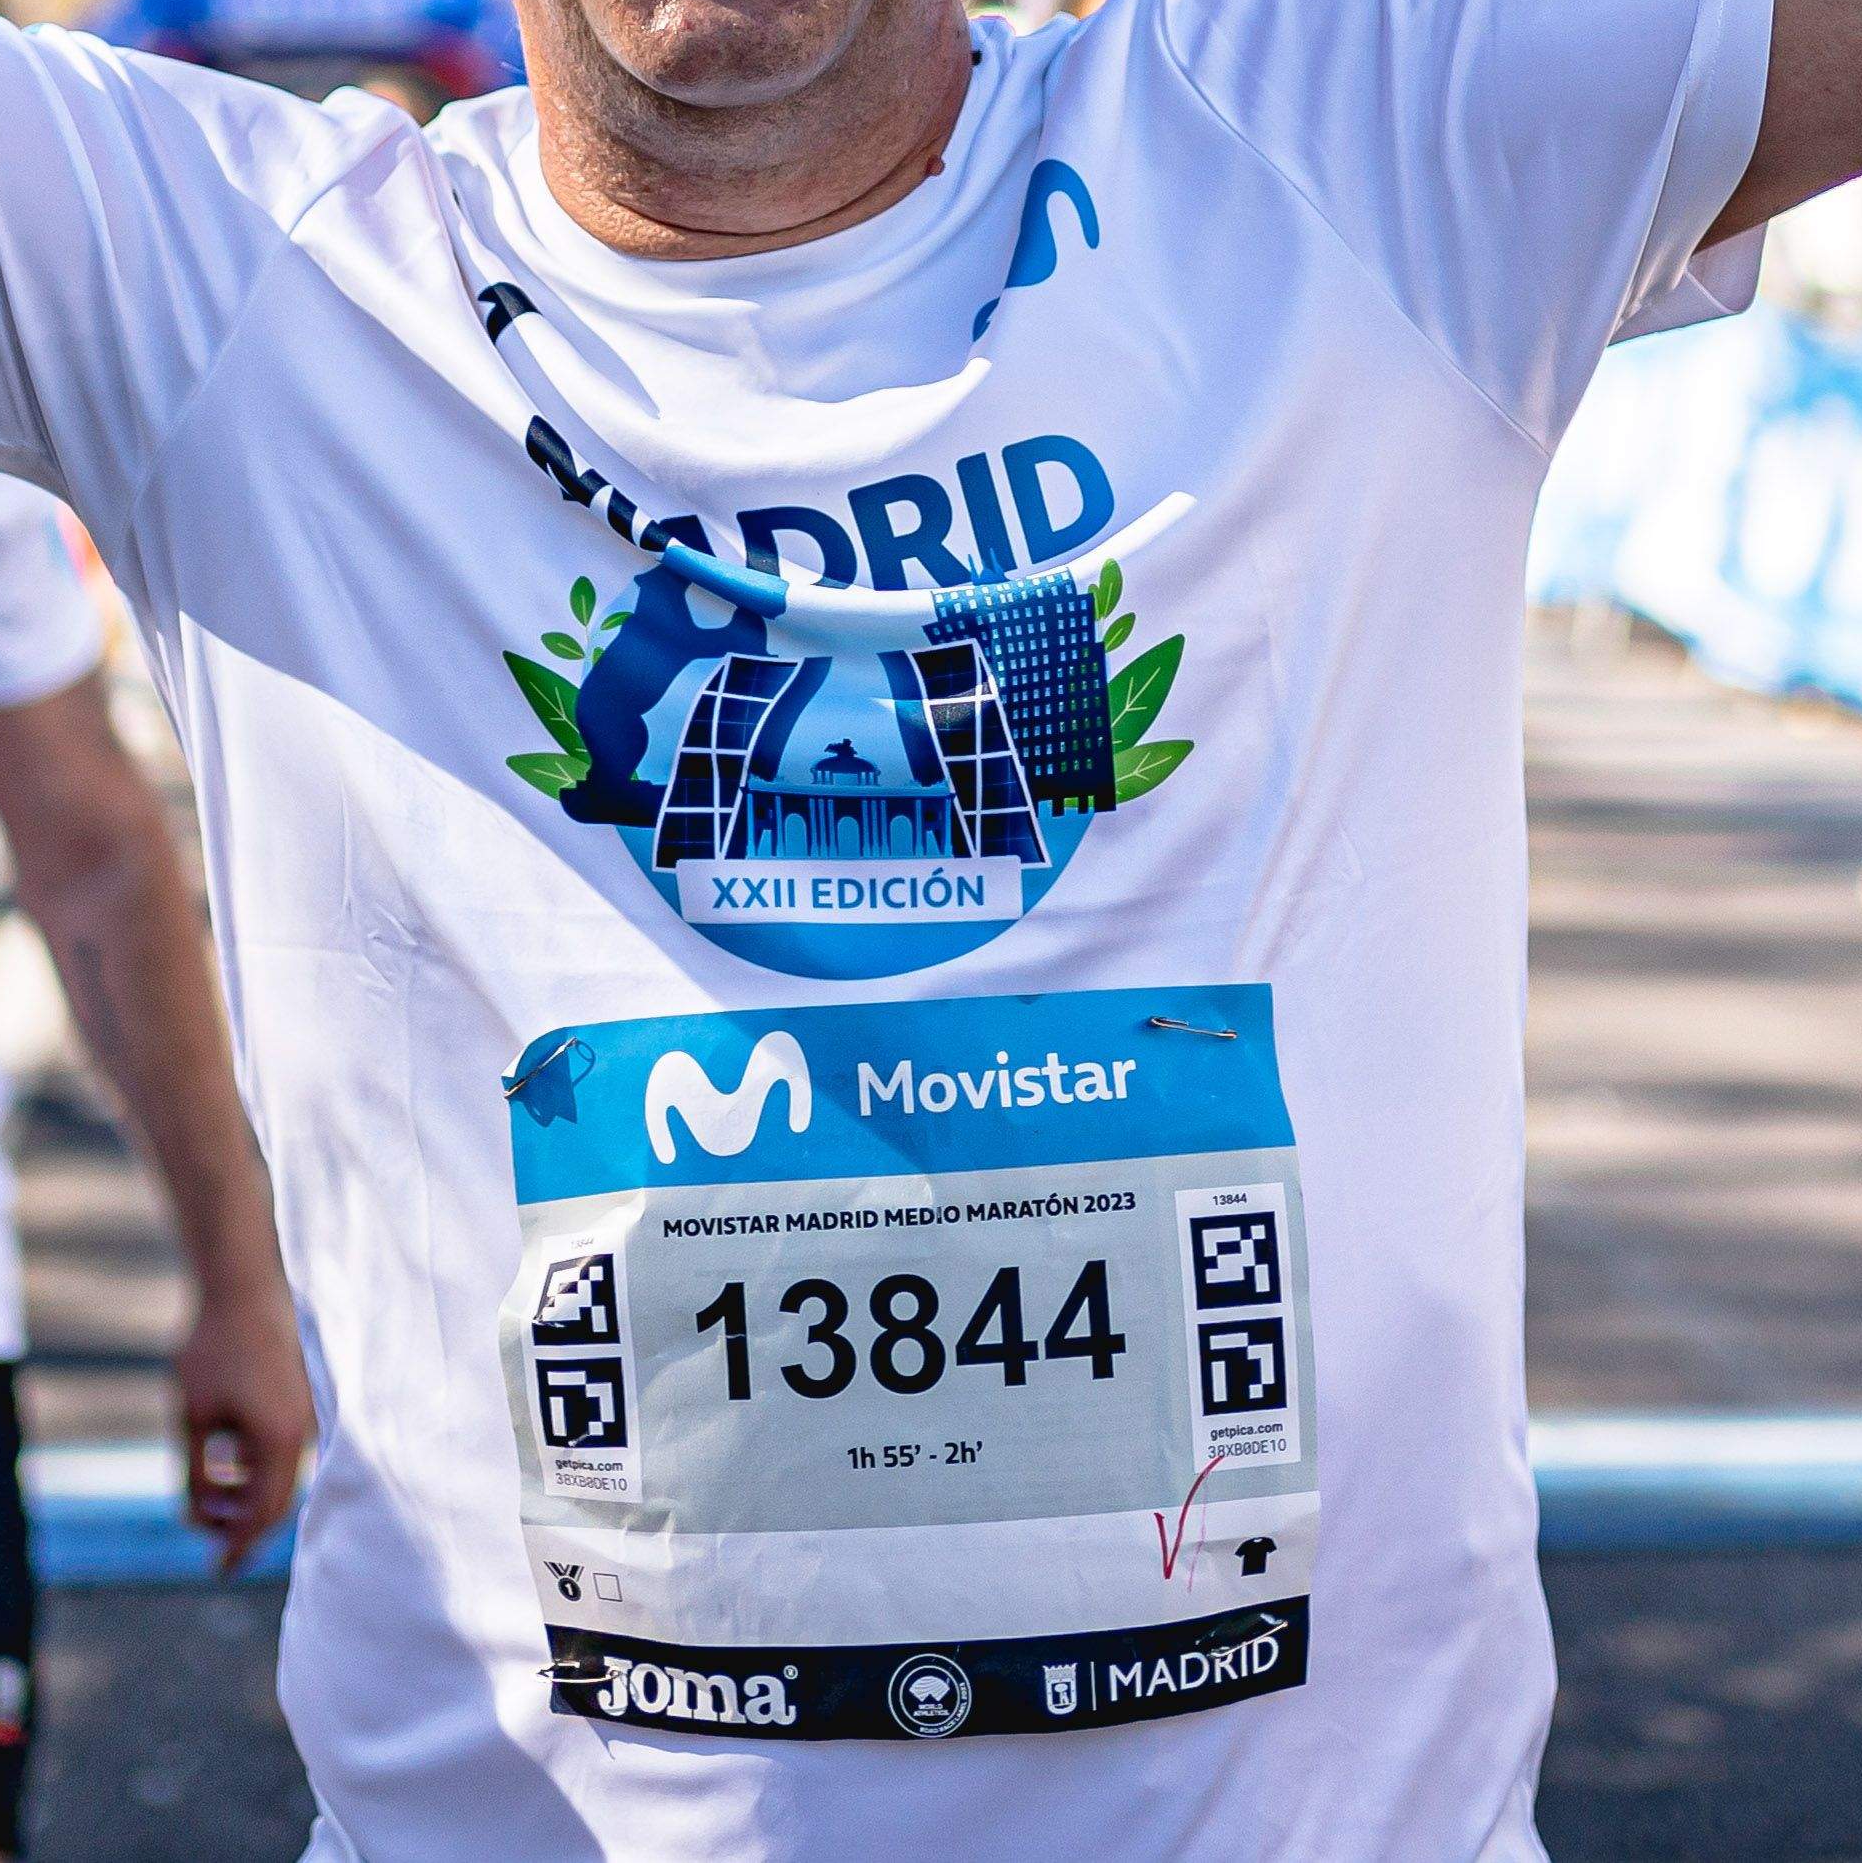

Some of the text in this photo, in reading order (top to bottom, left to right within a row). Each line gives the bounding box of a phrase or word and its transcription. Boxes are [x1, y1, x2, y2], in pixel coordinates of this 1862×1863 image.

[711, 867, 986, 909] XXII EDICIÓN
[857, 1050, 1137, 1117] Movistar
[662, 1191, 1137, 1239] MOVISTAR MADRID MEDIO MARATÓN 2023
[1212, 1193, 1248, 1206] 13844
[694, 1259, 1127, 1403] 13844
[1210, 1420, 1284, 1441] getpica.com
[555, 1458, 624, 1473] getpica.com
[847, 1446, 876, 1470] 1h
[1108, 1636, 1280, 1702] MADRID
